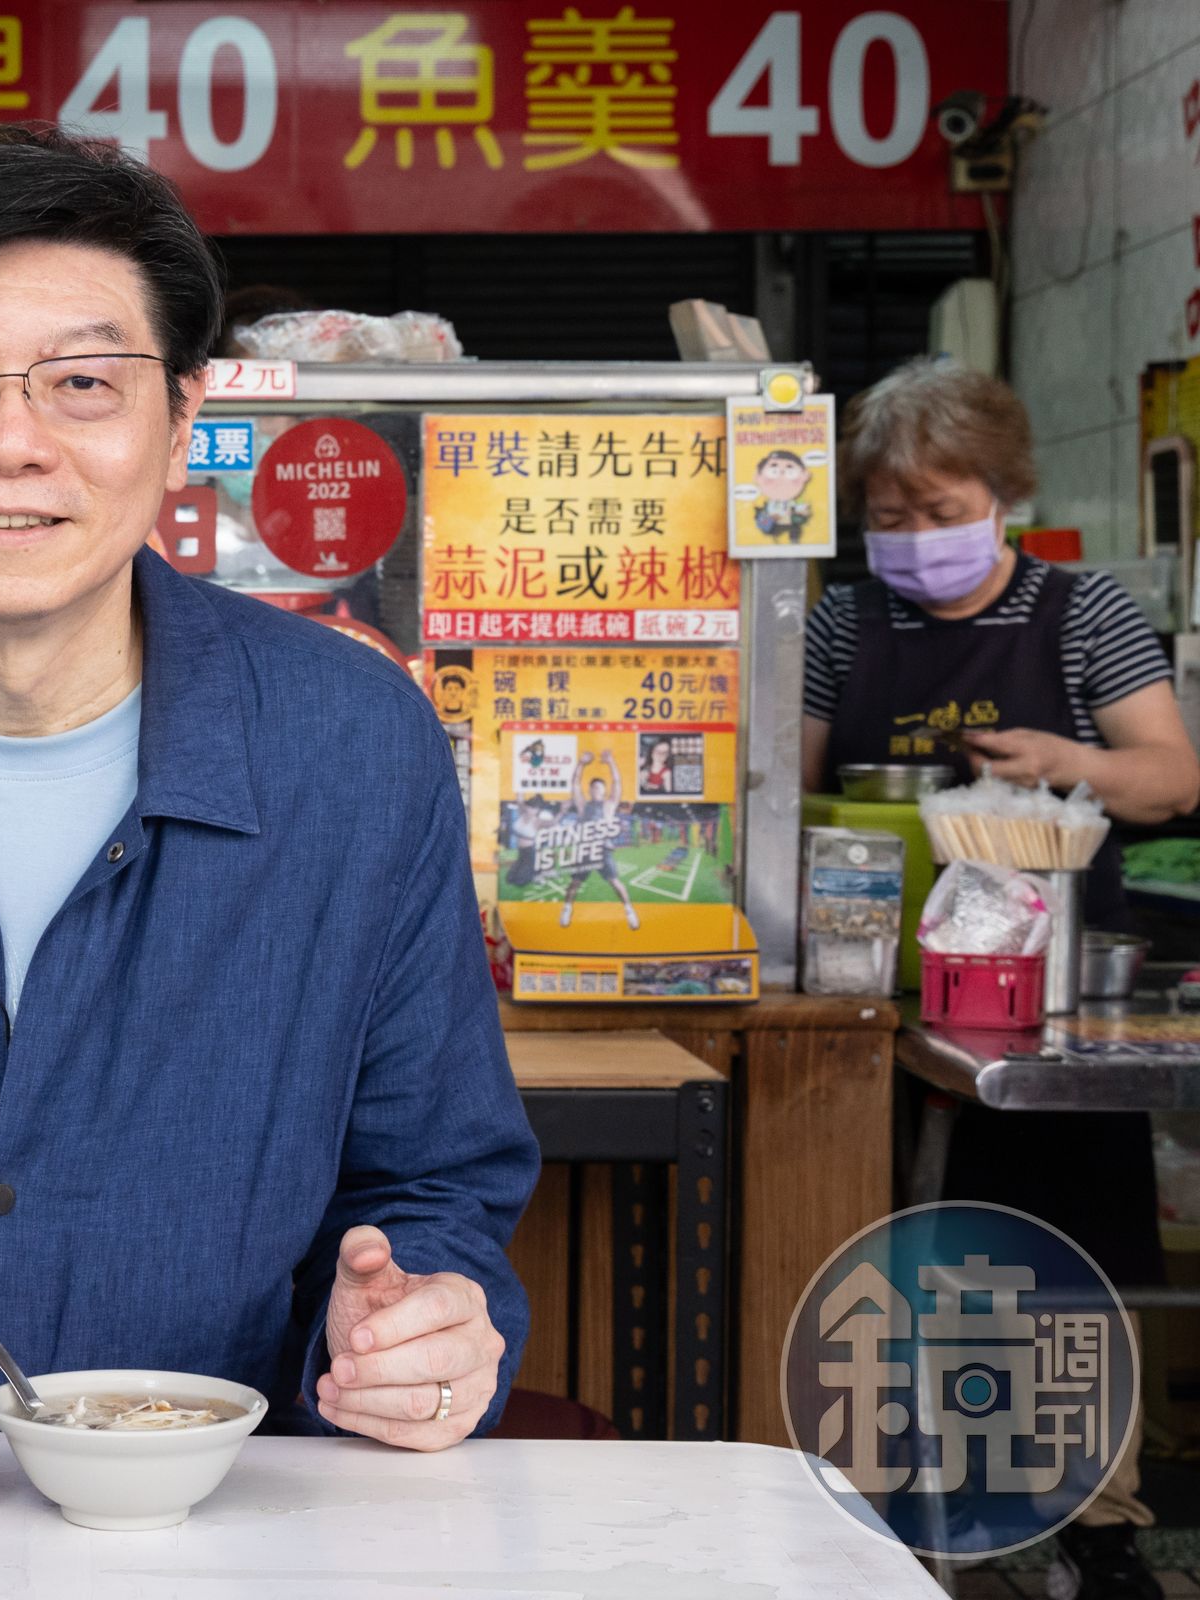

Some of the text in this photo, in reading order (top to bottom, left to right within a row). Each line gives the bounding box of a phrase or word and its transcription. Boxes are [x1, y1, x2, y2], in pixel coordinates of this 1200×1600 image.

[57, 15, 278, 171] 40
[344, 6, 678, 170] 魚羹
[707, 11, 931, 168] 40
[276, 459, 381, 481] MICHELIN
[434, 430, 728, 480] 單裝請先告知
[307, 481, 351, 500] 2022
[500, 498, 668, 536] 是否需要
[432, 545, 733, 602] 蒜泥或辣椒
[427, 613, 735, 639] 即日起不提供紙碗 紙碗2元
[534, 817, 621, 851] FITNESS
[534, 841, 604, 872] IS LIFE
